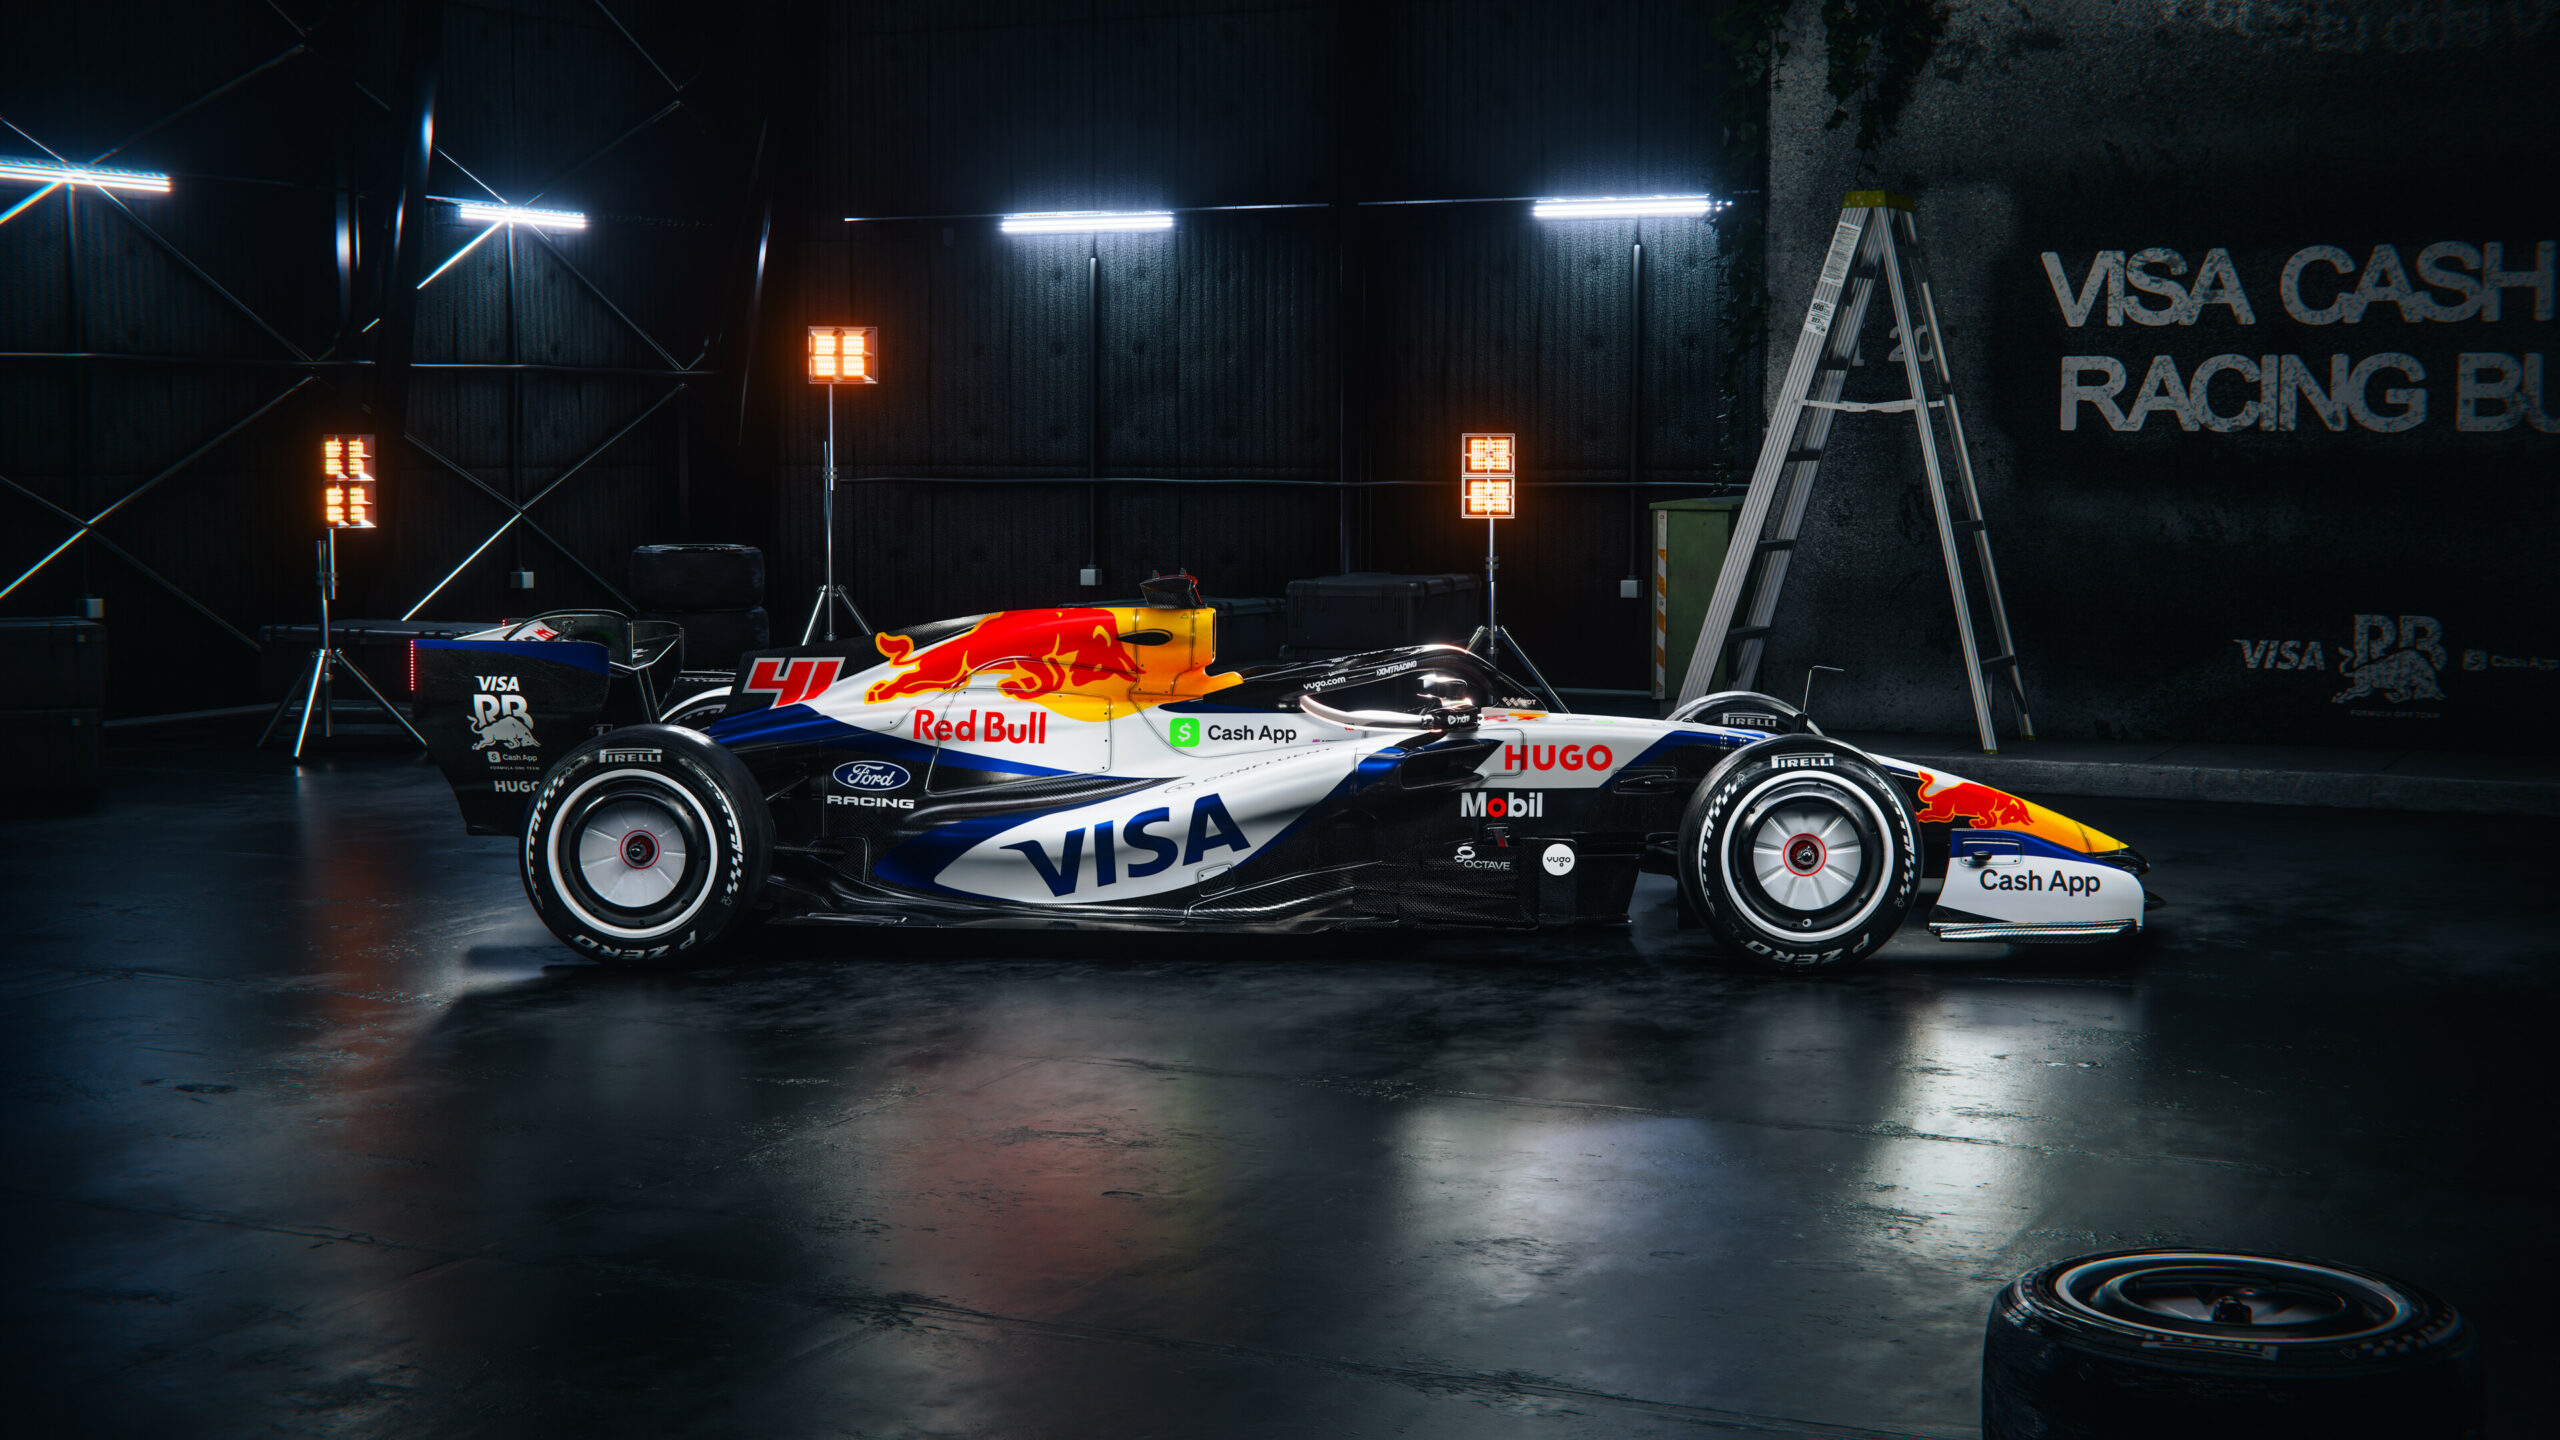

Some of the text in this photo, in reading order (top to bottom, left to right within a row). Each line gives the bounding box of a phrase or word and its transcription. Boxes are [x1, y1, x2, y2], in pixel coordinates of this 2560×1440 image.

[2040, 240, 2557, 328] VISA CASH
[2059, 352, 2428, 434] RACING
[2232, 638, 2326, 671] VISA
[474, 675, 520, 692] VISA
[741, 656, 846, 710] 41
[1303, 676, 1346, 692] yugo.com
[912, 709, 1047, 744] Red Bull
[1722, 712, 1777, 728] PIRELLI
[1207, 724, 1254, 741] Cash
[1258, 725, 1297, 744] App
[502, 753, 538, 763] Cash App
[599, 748, 663, 764] PIRELLI
[1504, 744, 1613, 771] HUGO
[1770, 752, 1834, 769] PIRELLI
[847, 763, 896, 788] Ford
[827, 794, 915, 810] RACING
[1460, 791, 1543, 818] Mobil
[999, 792, 1252, 898] VISA
[1463, 860, 1511, 870] OCTAVE
[1546, 856, 1571, 868] yugo
[1979, 869, 2101, 897] Cash App
[572, 930, 697, 961] P ZERO
[1744, 932, 1870, 965] P ZERO
